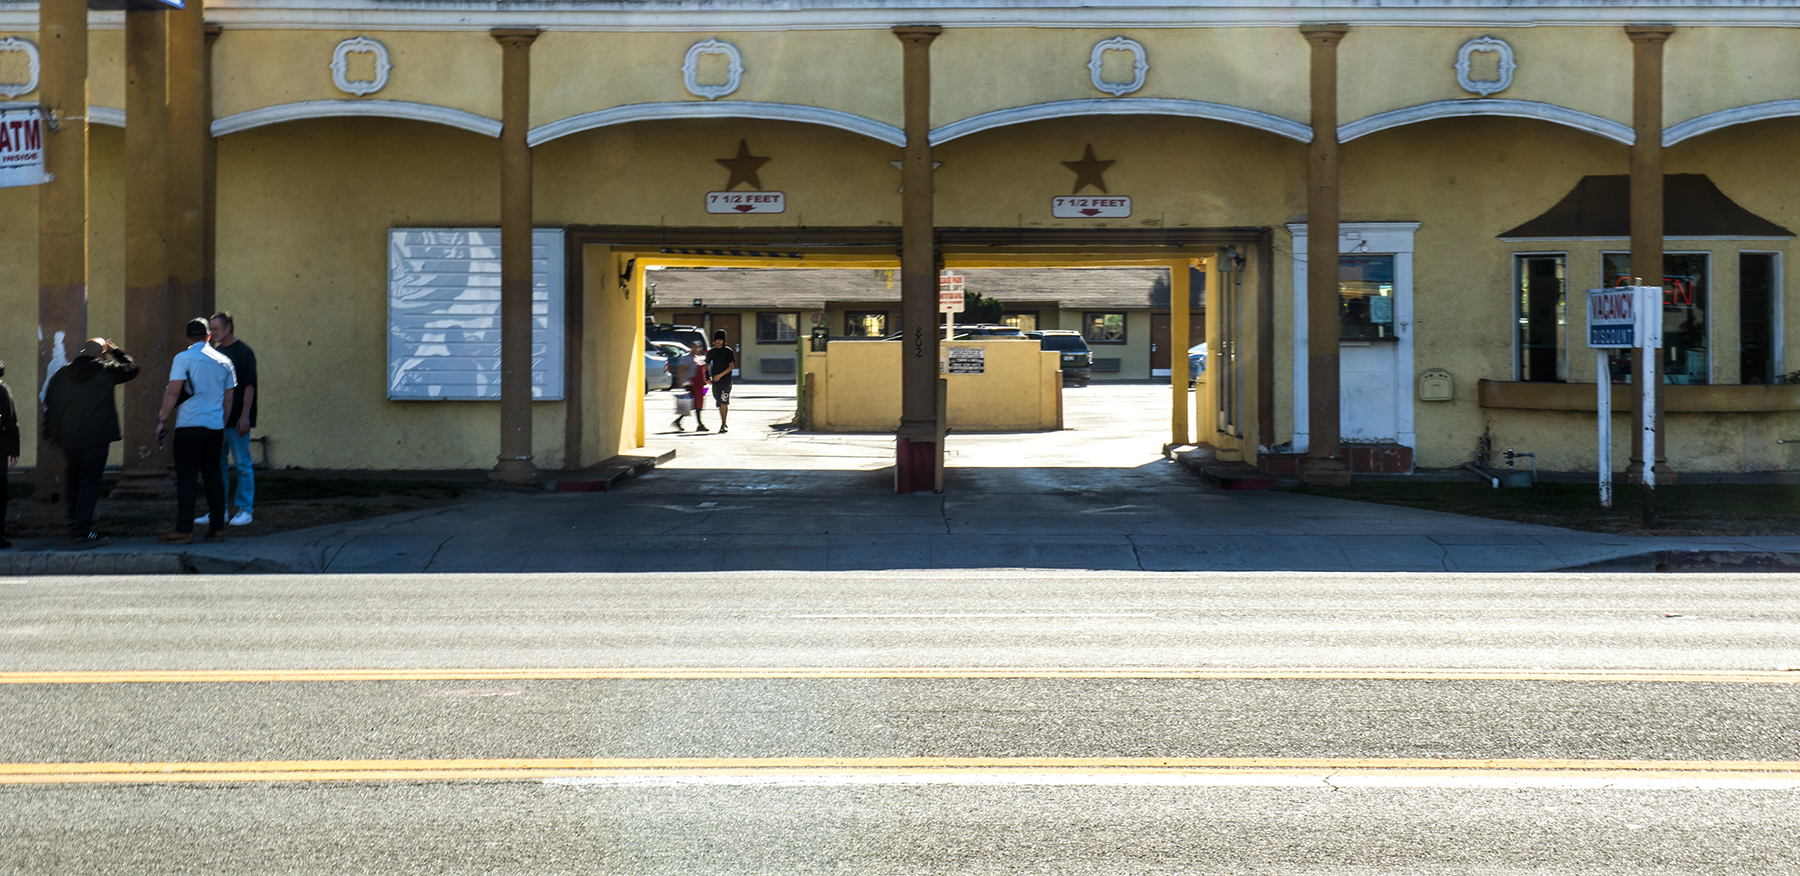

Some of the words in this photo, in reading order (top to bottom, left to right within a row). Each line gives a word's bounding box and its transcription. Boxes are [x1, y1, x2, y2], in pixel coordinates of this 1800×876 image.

[0, 119, 42, 152] ATM
[2, 153, 38, 163] INSIDE
[710, 195, 719, 203] 7
[722, 195, 742, 203] 1/2
[746, 195, 781, 203] FEET
[1056, 199, 1065, 207] 7
[1068, 199, 1088, 207] 1/2
[1092, 199, 1127, 207] FEET
[1591, 293, 1634, 320] VACANCY
[915, 326, 923, 358] 802
[1592, 328, 1633, 344] DISCOUNT
